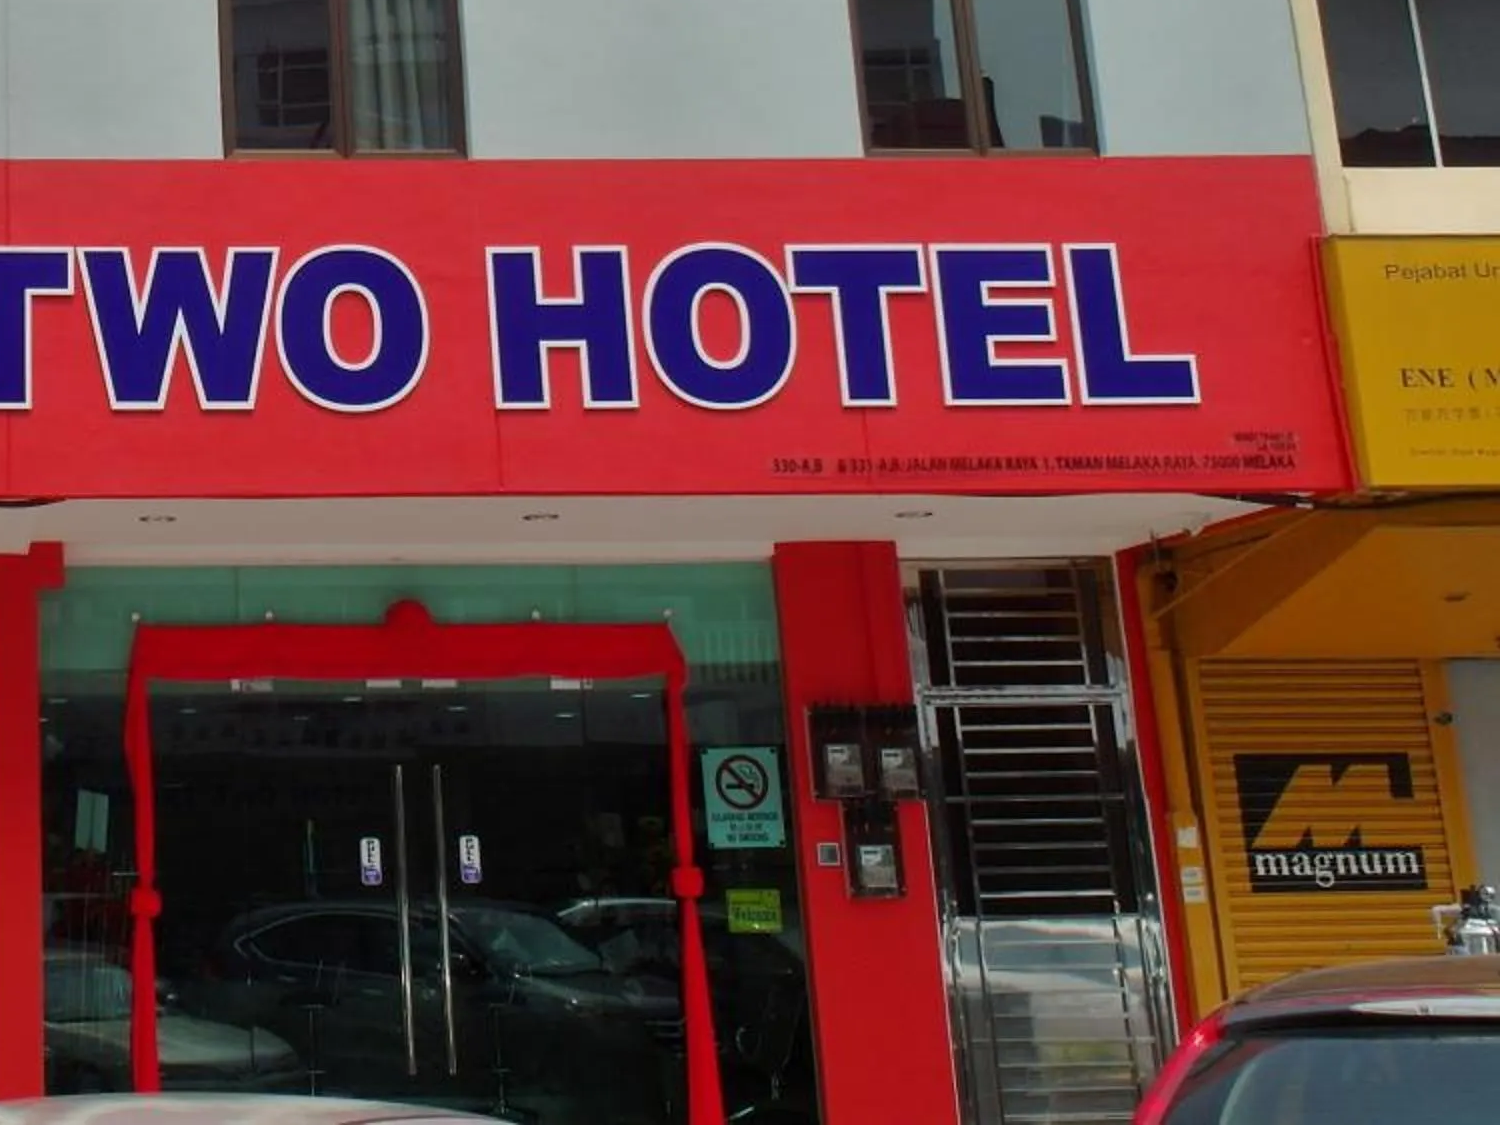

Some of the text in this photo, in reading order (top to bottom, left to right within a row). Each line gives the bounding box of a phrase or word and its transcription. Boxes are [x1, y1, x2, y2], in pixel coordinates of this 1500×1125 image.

[1384, 262, 1466, 283] Pejabat
[485, 242, 1201, 410] HOTEL
[1399, 368, 1455, 388] ENE
[907, 458, 948, 473] JALAN
[949, 458, 1003, 472] MELAKA
[1004, 457, 1039, 471] RAYA
[1055, 457, 1103, 471] TAMAN
[1105, 456, 1162, 470] MELAKA
[1241, 455, 1296, 470] MELAKA
[1254, 849, 1420, 888] magnum
